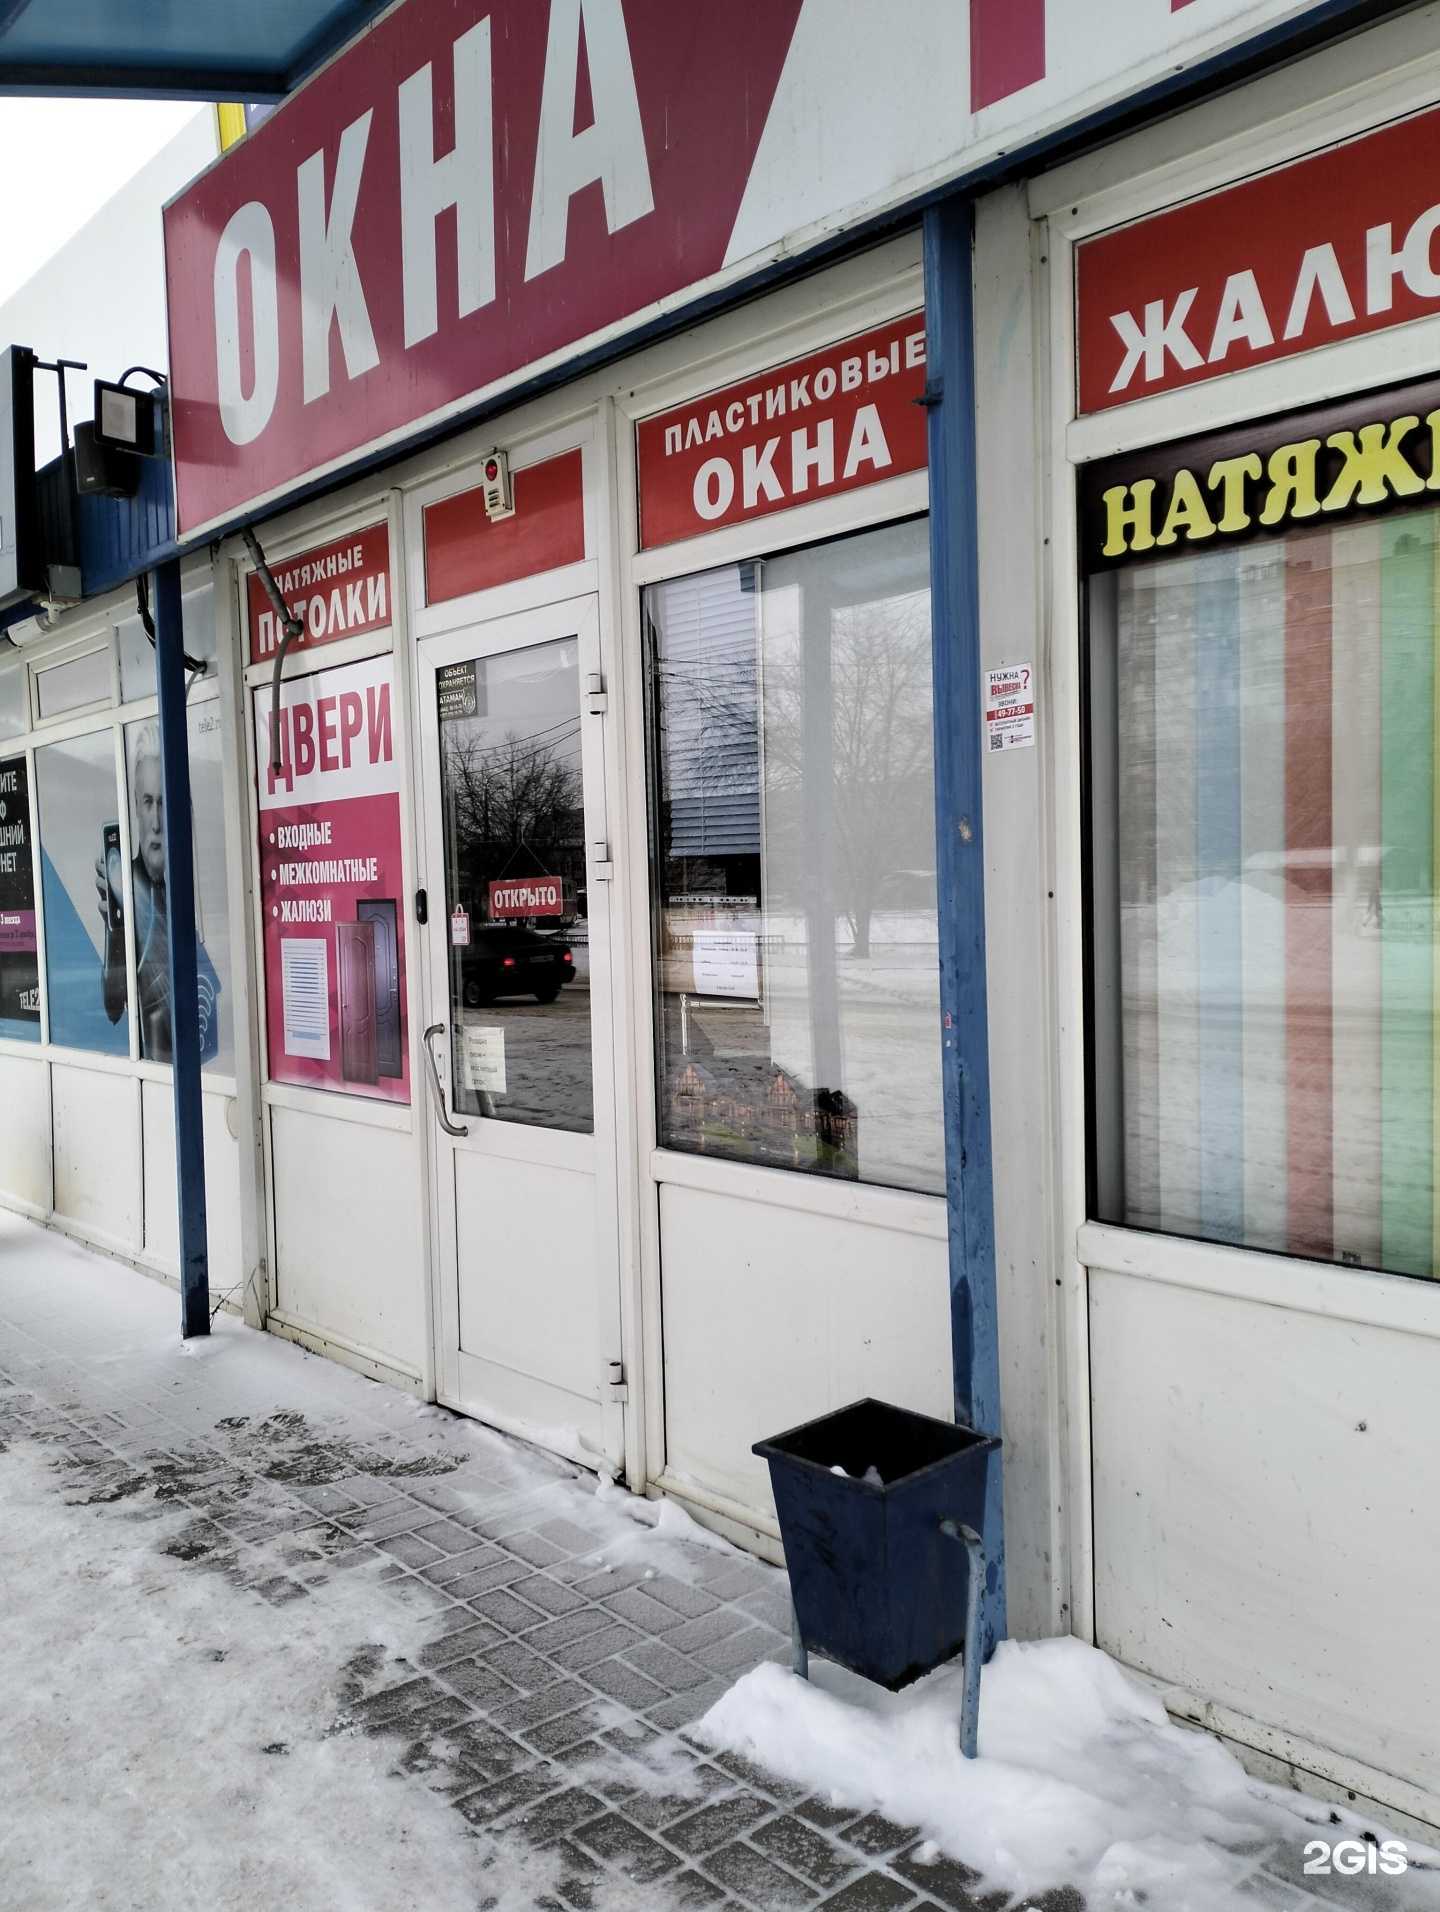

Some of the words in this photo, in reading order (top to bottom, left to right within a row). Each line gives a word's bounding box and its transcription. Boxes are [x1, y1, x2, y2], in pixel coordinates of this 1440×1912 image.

[214, 0, 654, 446] ОКНА
[1108, 203, 1440, 393] ЖАЛЮ
[665, 330, 927, 456] ПЛАСТИКОВЫЕ
[693, 403, 892, 520] ОКНА
[990, 671, 1019, 682] НУЖНА
[268, 682, 393, 794] ДВЕРИ
[278, 822, 332, 850] ВХОДНЫЕ
[280, 858, 378, 885] МЕЖКОМНАТНЫЕ
[494, 886, 556, 908] ОТКРЫТО
[281, 899, 332, 922] ЖАЛЮЗИ
